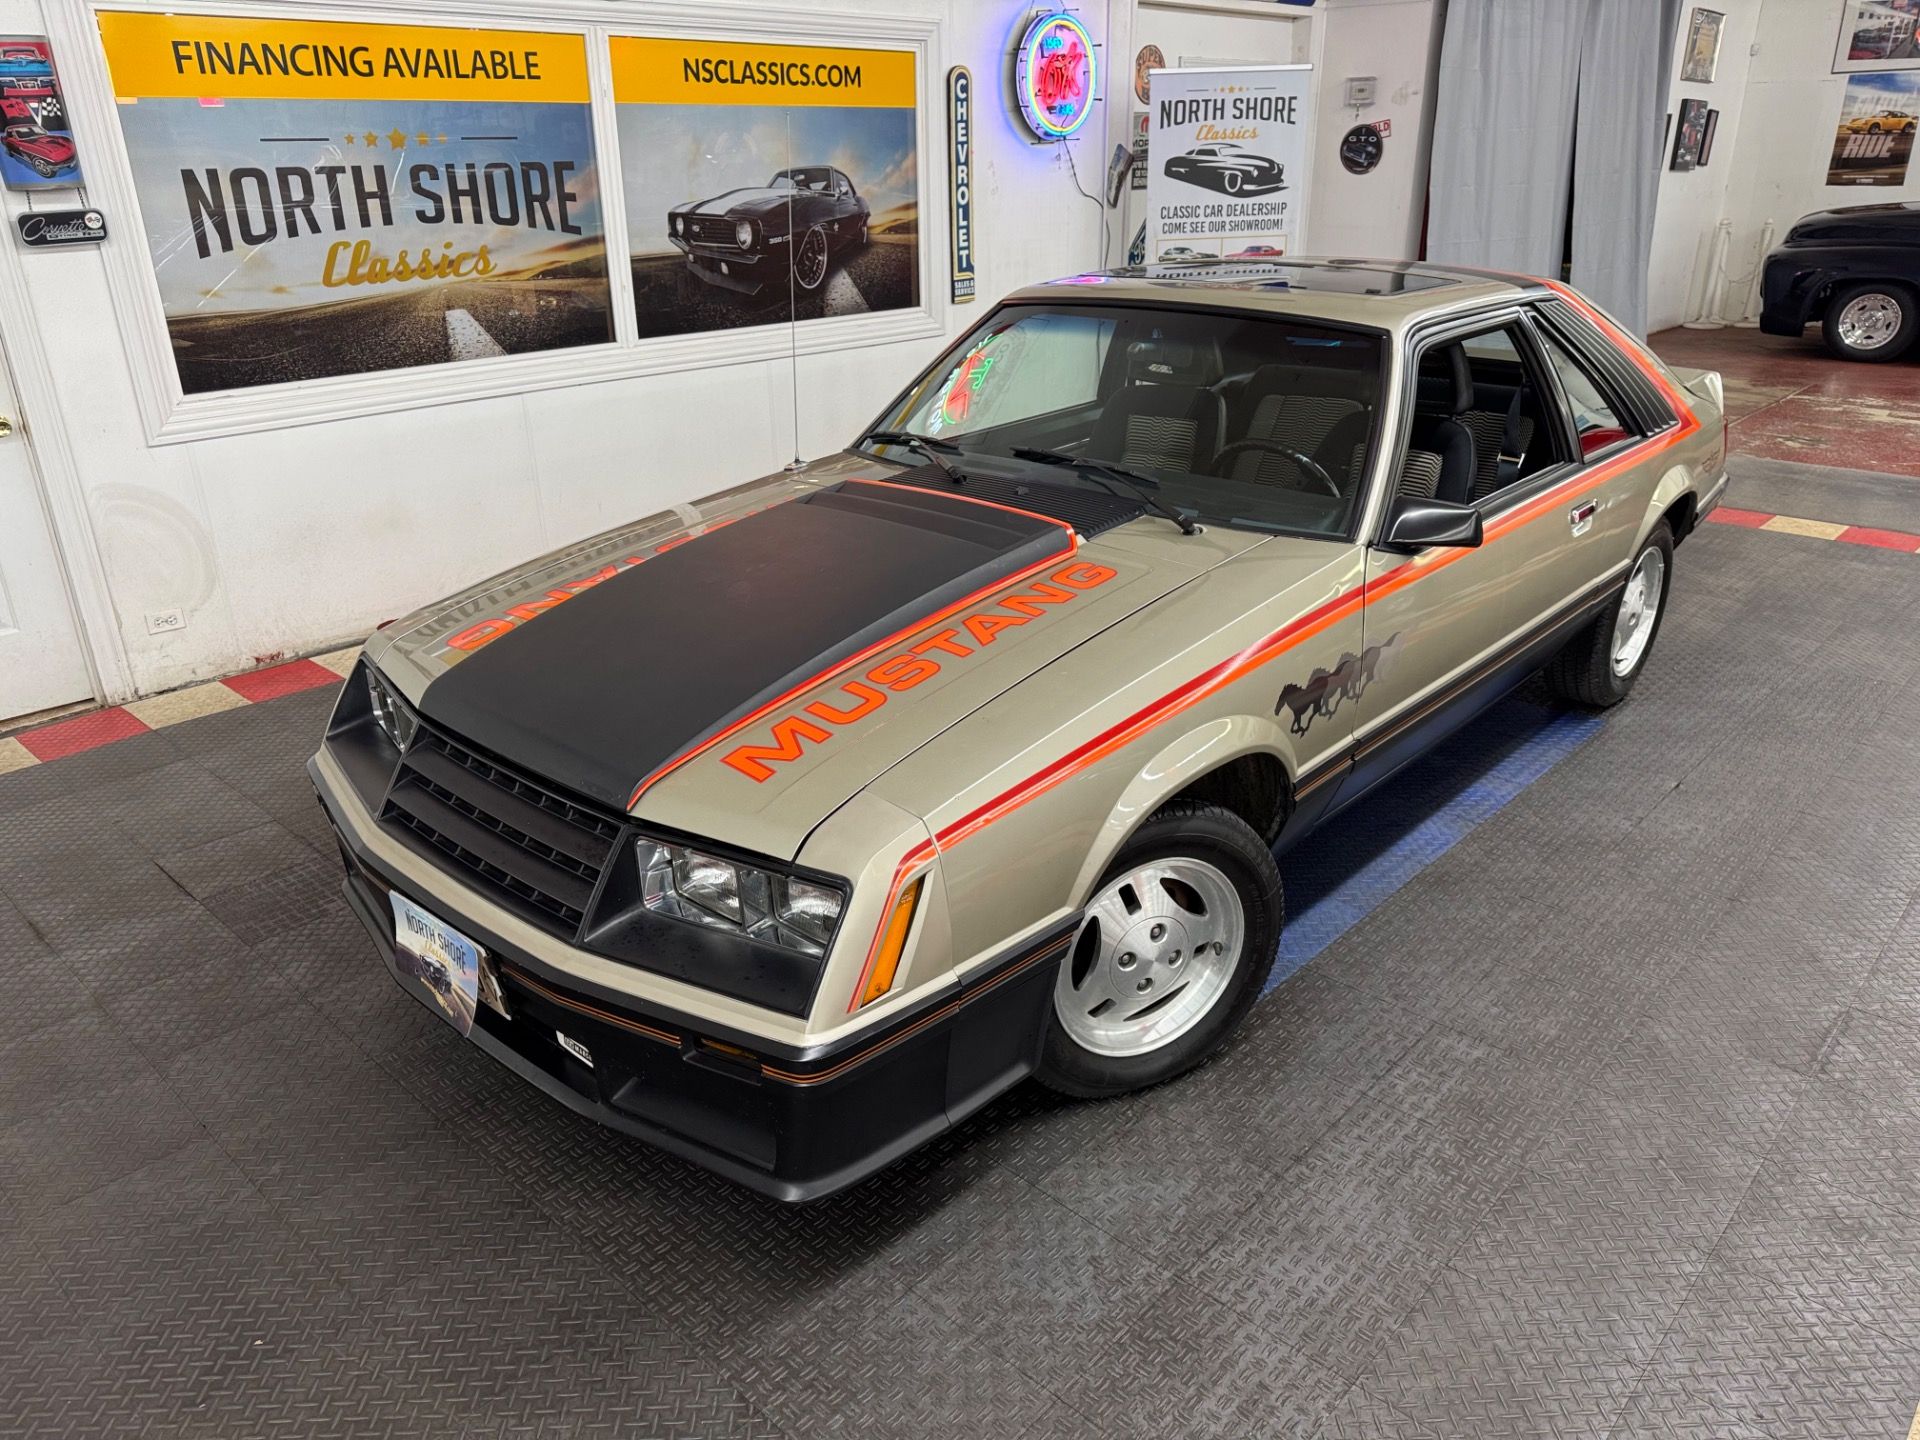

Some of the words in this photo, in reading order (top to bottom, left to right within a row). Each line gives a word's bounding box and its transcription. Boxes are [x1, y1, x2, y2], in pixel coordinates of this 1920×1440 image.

[171, 41, 374, 78] FINANCING
[383, 46, 542, 81] AVAILABLE
[683, 57, 862, 89] NSCLASSICS.COM
[1159, 98, 1226, 130] NORTH
[1232, 95, 1298, 125] SHORE
[1195, 124, 1260, 142] Classics
[1841, 134, 1896, 159] RIDE
[955, 78, 970, 269] CHEVROLET
[180, 164, 402, 260] NORTH
[411, 160, 583, 236] SHORE
[1160, 205, 1201, 220] CLASSIC
[1203, 204, 1224, 218] CAR
[1226, 202, 1288, 217] DEALERSHIP
[1162, 221, 1188, 235] COME
[1189, 220, 1206, 233] SEE
[1208, 220, 1226, 233] OUR
[1228, 218, 1283, 232] SHOWROOM!
[23, 217, 85, 240] Corvette
[321, 239, 498, 288] Classics
[719, 562, 1118, 784] MUSTANG
[404, 909, 436, 943] NORTH
[437, 932, 467, 975] SHORE
